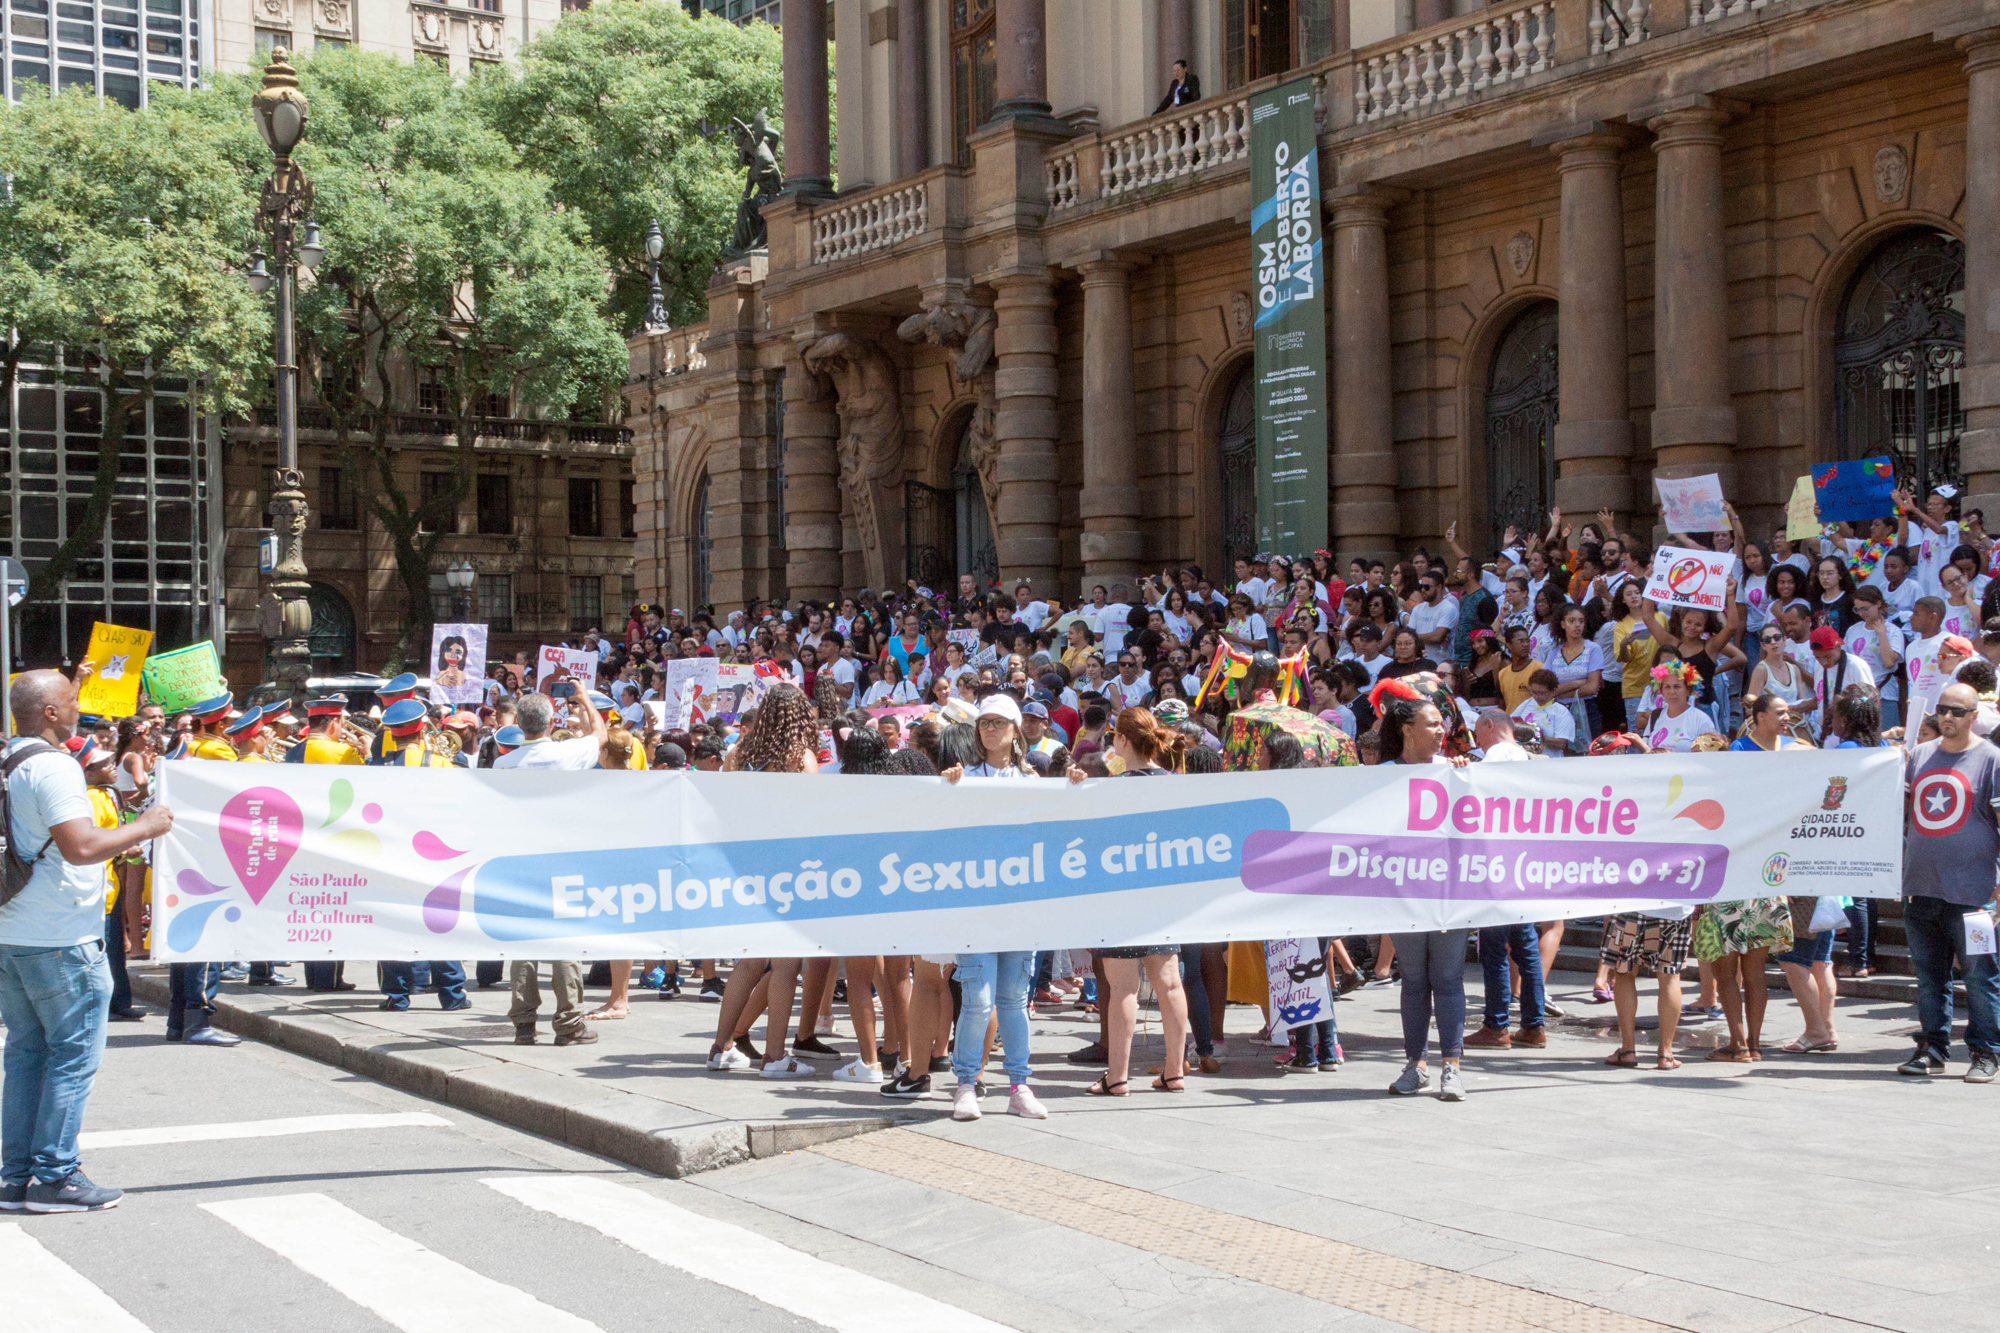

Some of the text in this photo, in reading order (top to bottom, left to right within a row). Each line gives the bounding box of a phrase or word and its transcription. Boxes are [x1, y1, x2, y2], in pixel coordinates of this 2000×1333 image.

[1275, 141, 1292, 304] E ROBERTO
[1291, 155, 1314, 301] LABORDA
[1258, 241, 1277, 308] OSM
[1709, 564, 1724, 576] NÃO
[1648, 587, 1670, 600] ABUSO
[544, 649, 566, 662] CCA
[569, 662, 588, 672] FREI
[1406, 778, 1640, 836] Denuncie
[1801, 814, 1856, 824] CIDADE DE
[246, 800, 264, 876] carnaval
[264, 816, 278, 861] de rua
[1790, 825, 1865, 839] SÃO PAULO
[1329, 844, 1707, 892] Disque 156 (aperte 0 + 3)
[289, 872, 368, 887] São Paulo
[551, 832, 1232, 924] Exploração Sexual é crime
[288, 891, 348, 909] Capital
[286, 910, 374, 924] da Cultura
[286, 928, 332, 942] 2020
[1268, 938, 1298, 956] LERTAR
